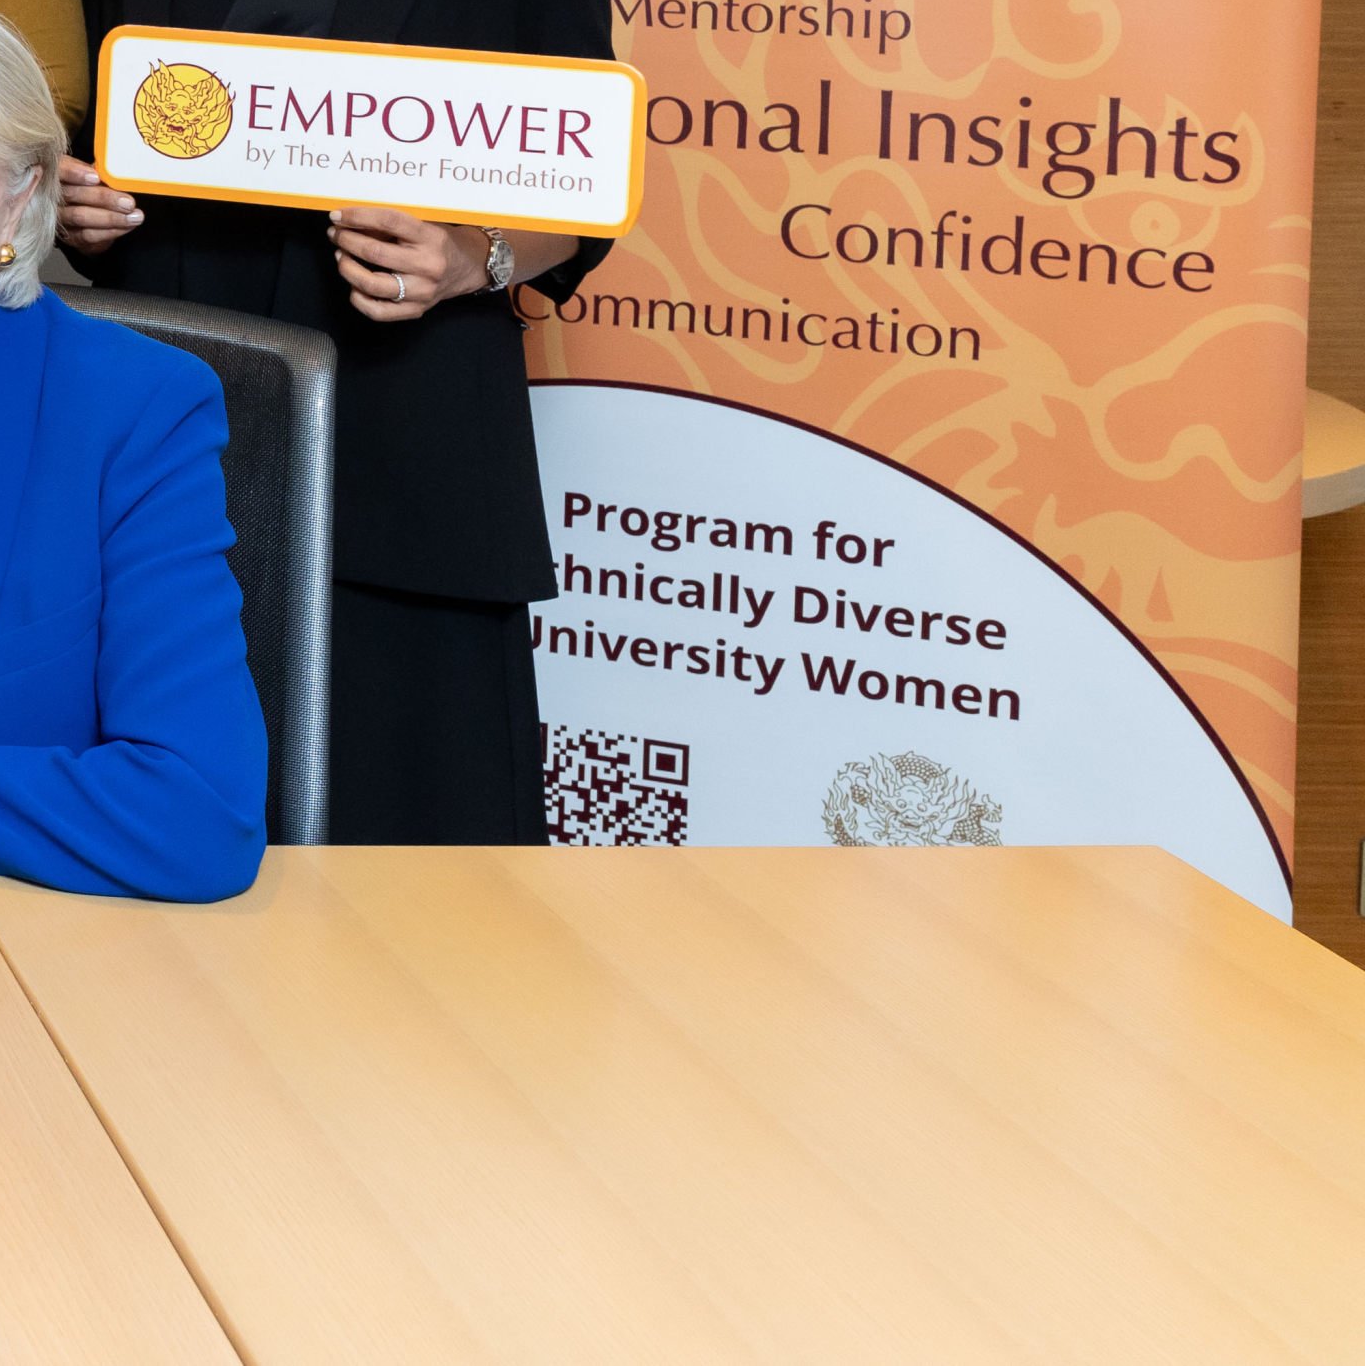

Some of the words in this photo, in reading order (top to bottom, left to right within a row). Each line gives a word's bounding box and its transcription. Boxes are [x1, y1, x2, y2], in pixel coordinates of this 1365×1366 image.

[248, 84, 593, 158] EMPOWER
[646, 80, 831, 155] onal
[878, 90, 1241, 199] Insights
[245, 140, 275, 170] by
[286, 144, 331, 169] The
[339, 150, 428, 178] Amber
[439, 159, 593, 193] Foundation
[780, 204, 1215, 293] Confidence
[513, 284, 981, 361] Communication
[563, 492, 793, 556] Program
[813, 520, 895, 567] for
[553, 553, 775, 628] hnically
[793, 586, 1007, 650] Diverse
[801, 652, 1020, 721] Women
